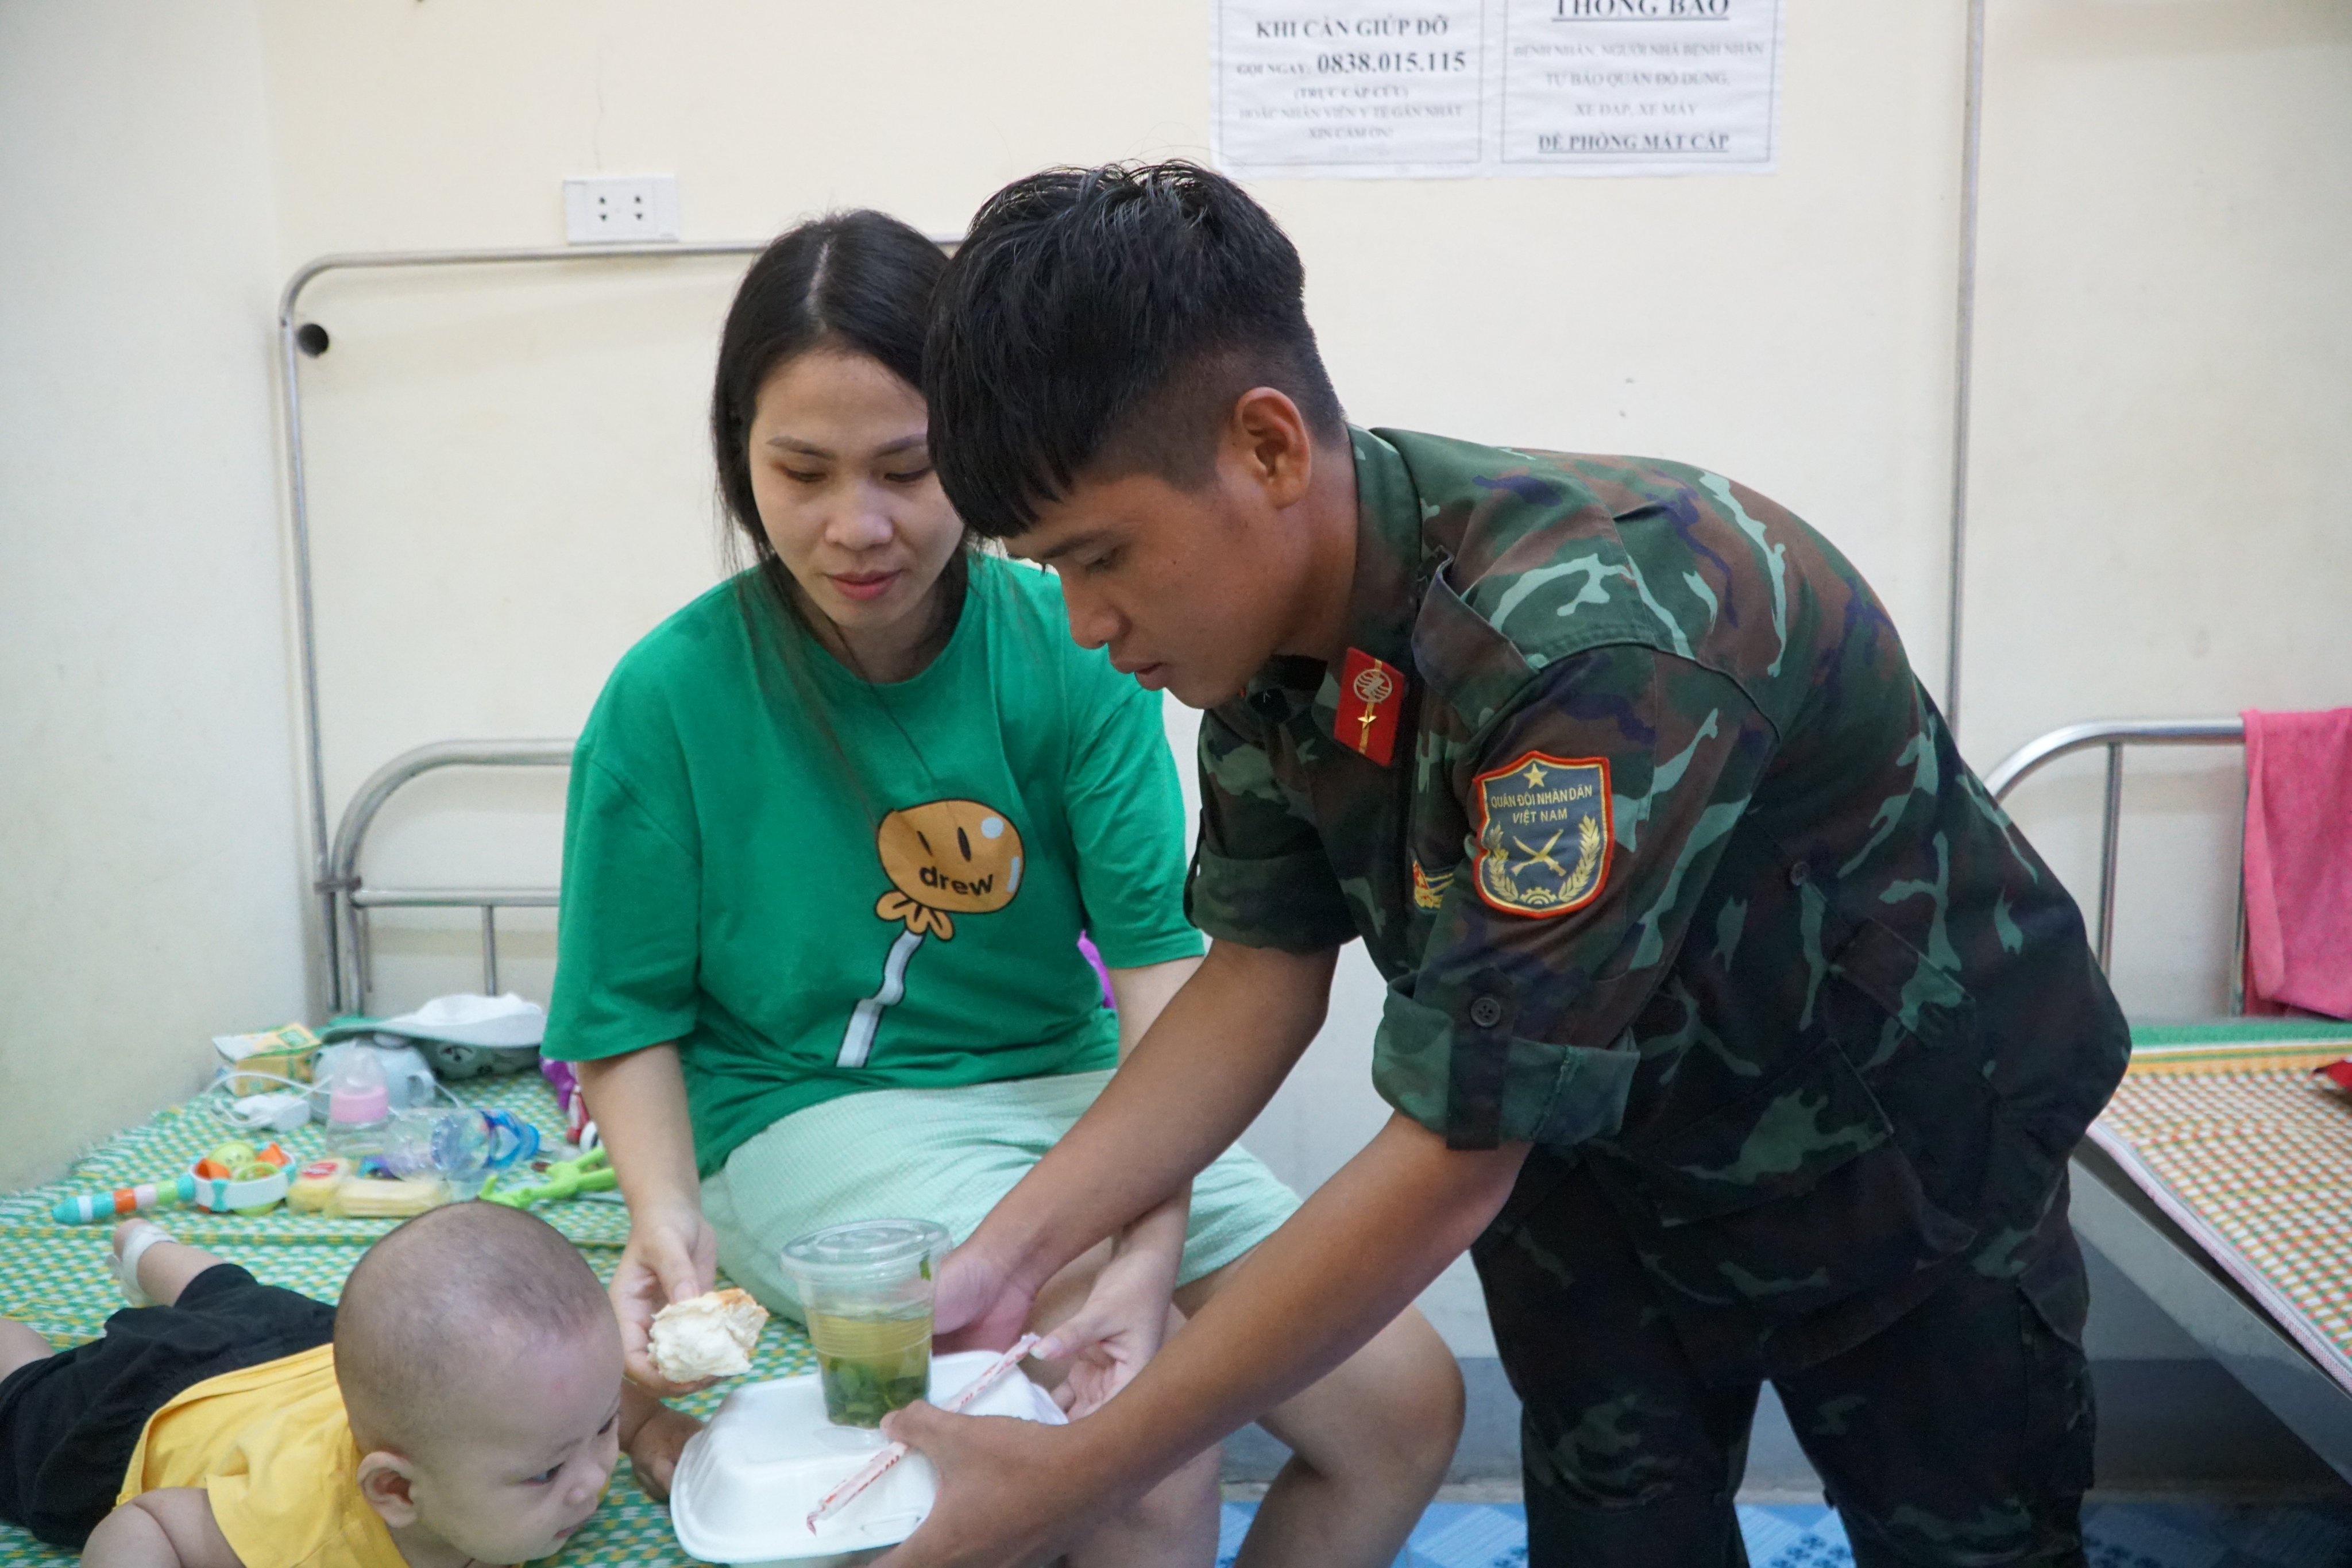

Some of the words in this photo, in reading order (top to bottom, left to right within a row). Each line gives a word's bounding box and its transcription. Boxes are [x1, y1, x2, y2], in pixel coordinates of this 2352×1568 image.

[1256, 21, 1296, 37] KHI
[1356, 13, 1410, 37] GIÚP
[1317, 51, 1466, 74] 0838.015.115
[1512, 809, 1537, 826] VIỆT
[1540, 808, 1568, 822] NAM
[920, 866, 993, 895] drew
